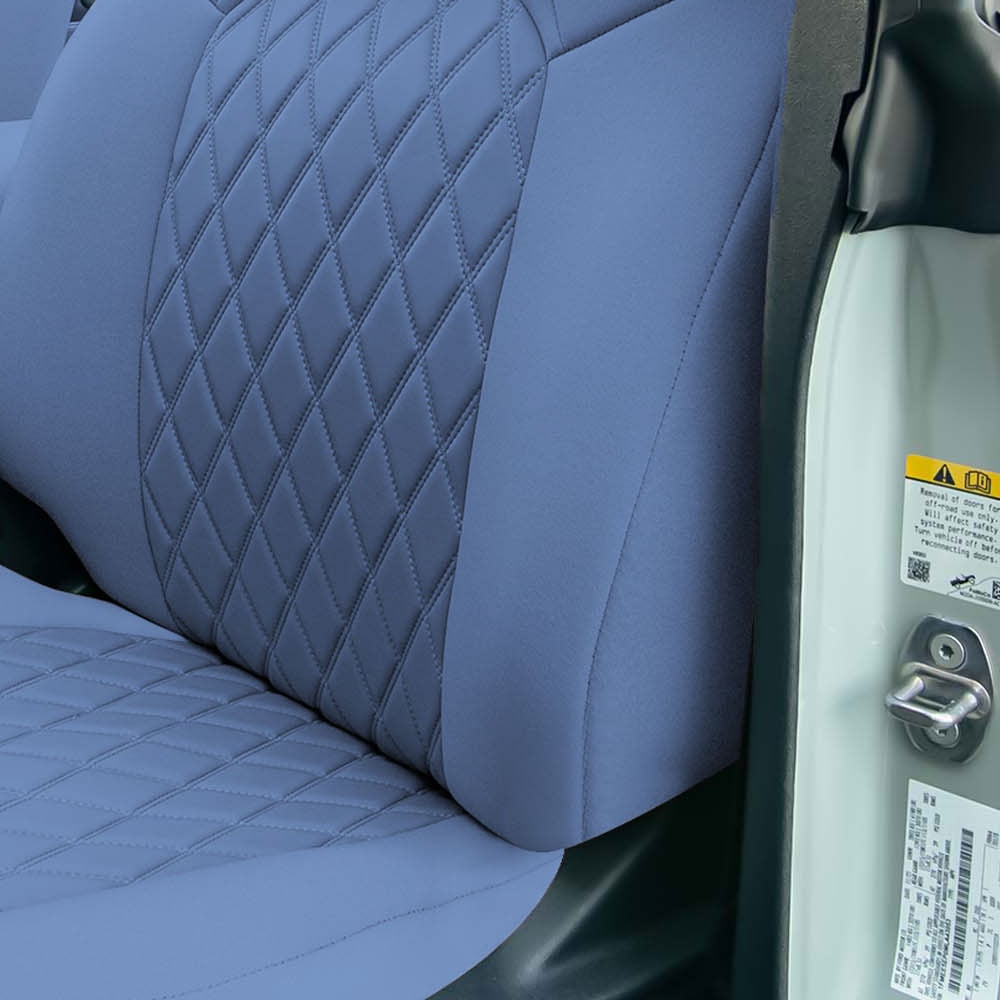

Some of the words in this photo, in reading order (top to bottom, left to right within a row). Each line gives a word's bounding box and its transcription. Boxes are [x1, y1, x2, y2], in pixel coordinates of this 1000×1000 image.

[920, 487, 949, 501] Removal
[951, 495, 960, 504] of
[964, 499, 984, 510] doors
[924, 508, 941, 520] Will
[945, 514, 969, 526] affect
[973, 521, 999, 535] safety
[925, 499, 958, 514] off-road
[961, 509, 974, 517] use
[978, 512, 998, 524] only.
[914, 525, 931, 535] Turn
[934, 532, 962, 545] vehicle
[965, 539, 978, 548] off
[920, 519, 945, 530] system
[948, 525, 997, 543] performance.
[921, 538, 970, 558] reconnecting
[973, 551, 998, 563] doors.
